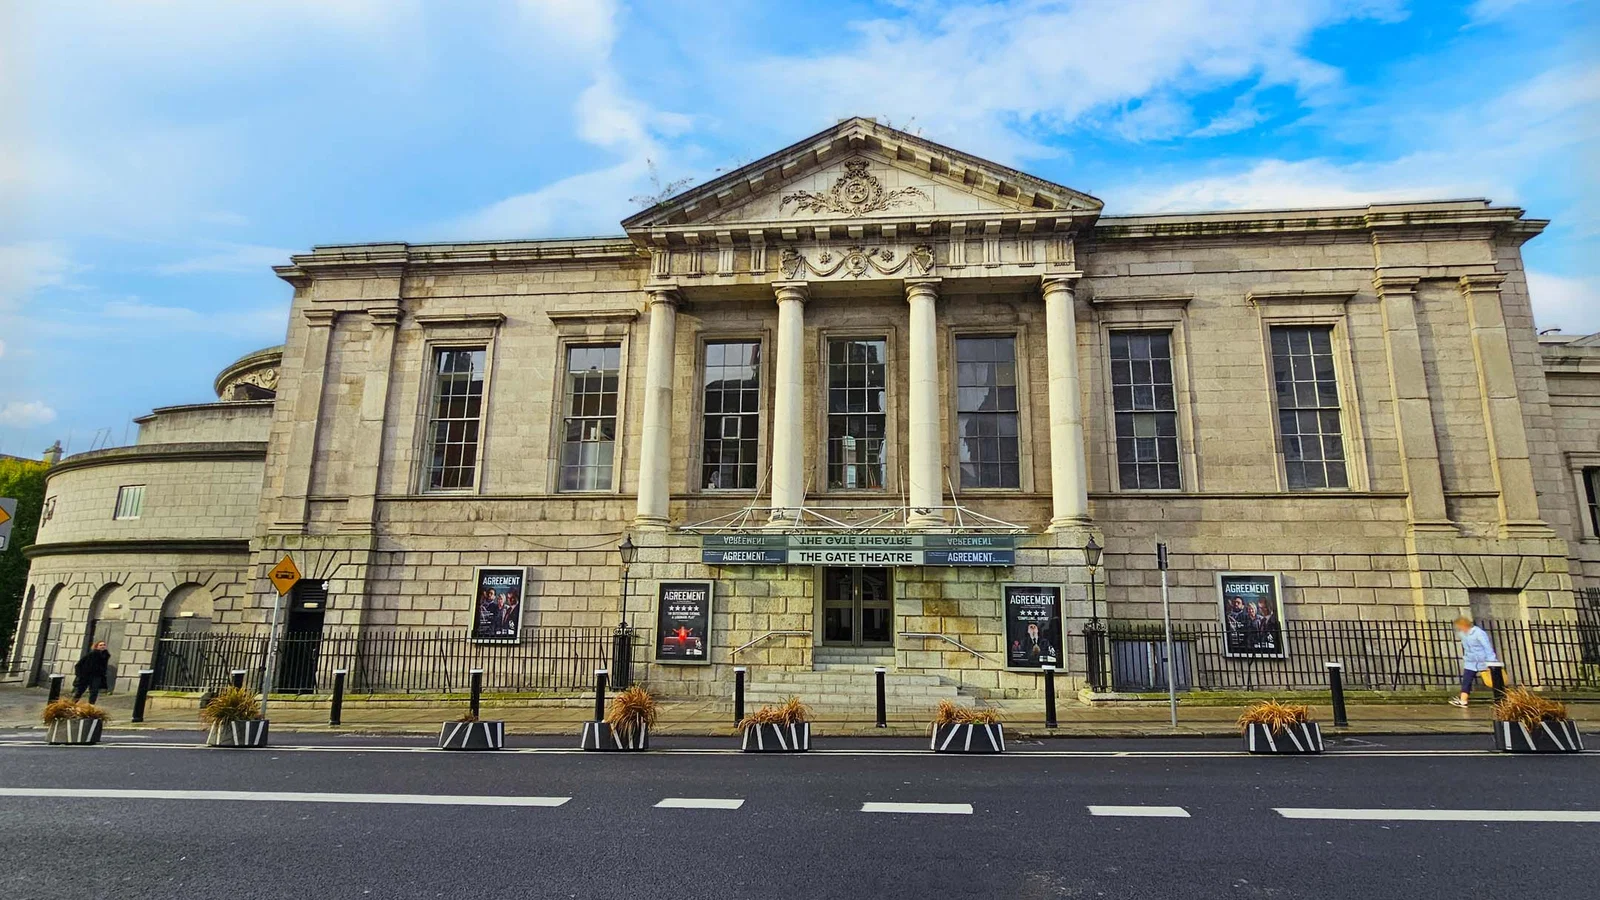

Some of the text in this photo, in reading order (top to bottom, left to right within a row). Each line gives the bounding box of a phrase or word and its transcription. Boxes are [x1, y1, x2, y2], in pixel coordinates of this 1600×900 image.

[722, 551, 766, 561] AGREEMENT
[799, 552, 912, 562] THE GATE THEATRE
[947, 552, 993, 562] AGREEMENT
[482, 577, 520, 586] AGREEMENT
[1225, 584, 1270, 593] AGREEMENT
[664, 591, 705, 600] AGREEMENT
[1010, 595, 1055, 605] AGREEMENT
